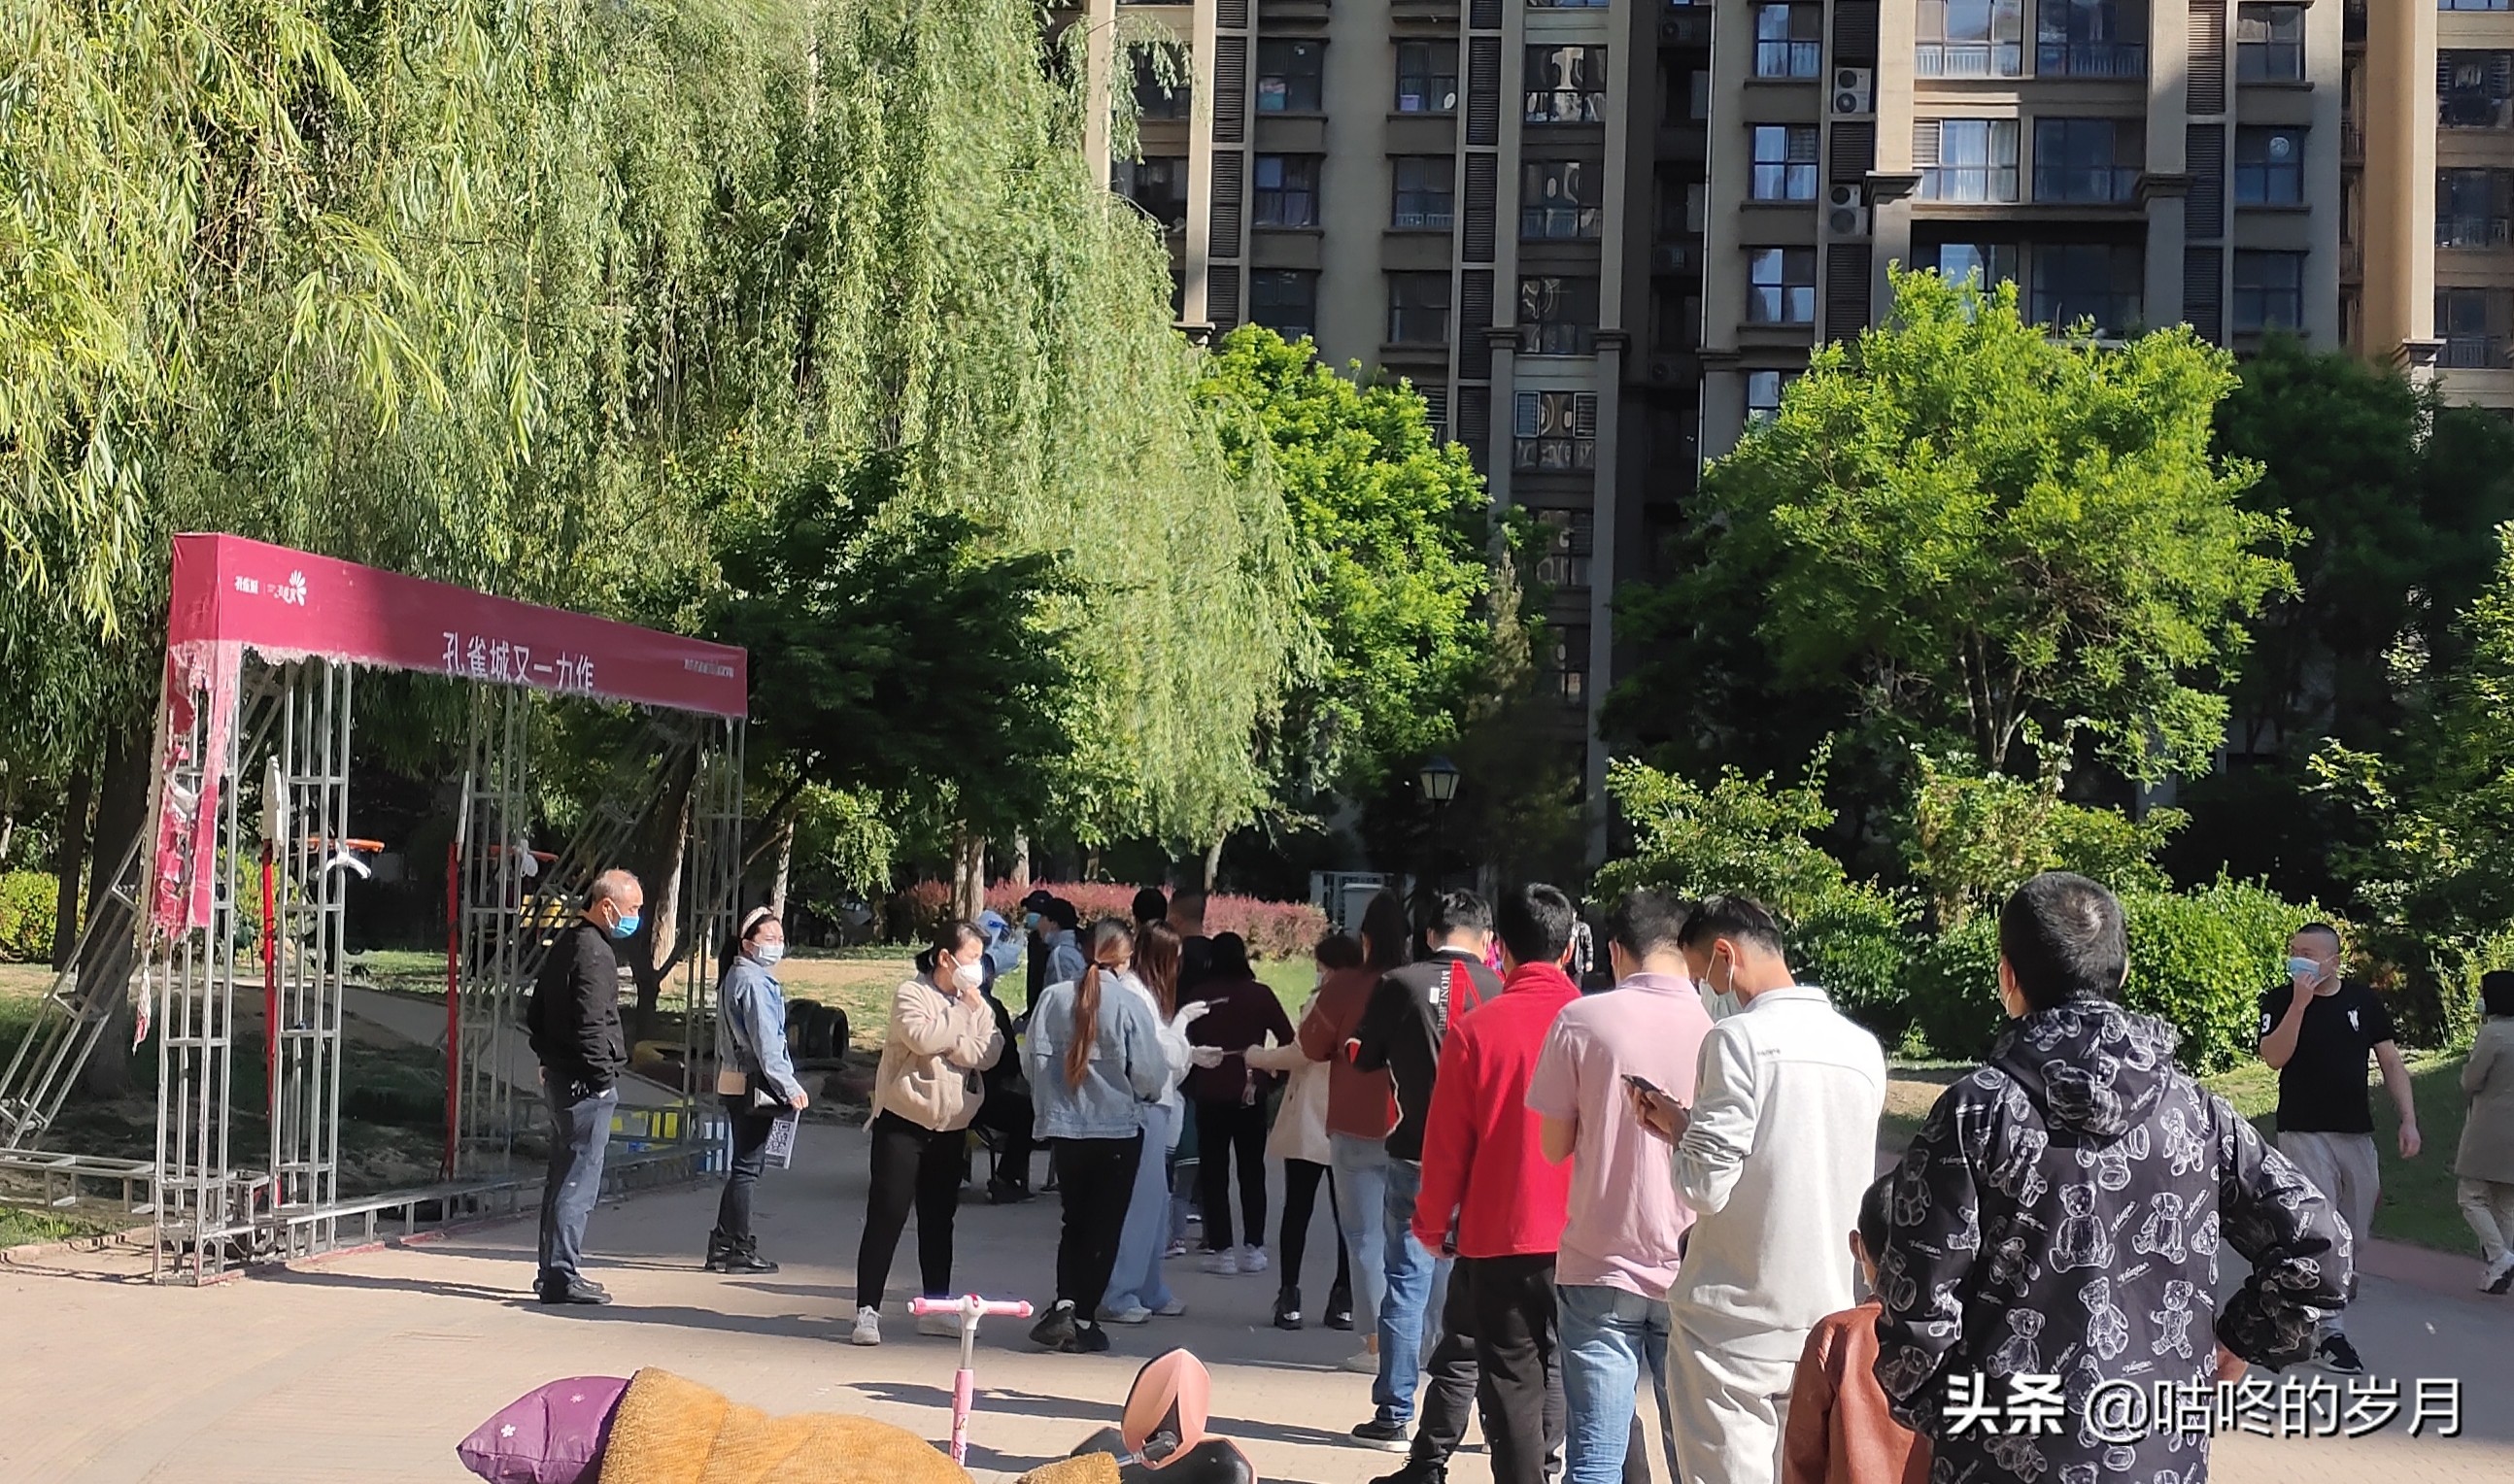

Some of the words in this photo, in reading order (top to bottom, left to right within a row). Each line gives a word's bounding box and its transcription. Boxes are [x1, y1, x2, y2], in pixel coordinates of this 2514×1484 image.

[442, 631, 595, 692] 孔雀城又一力作
